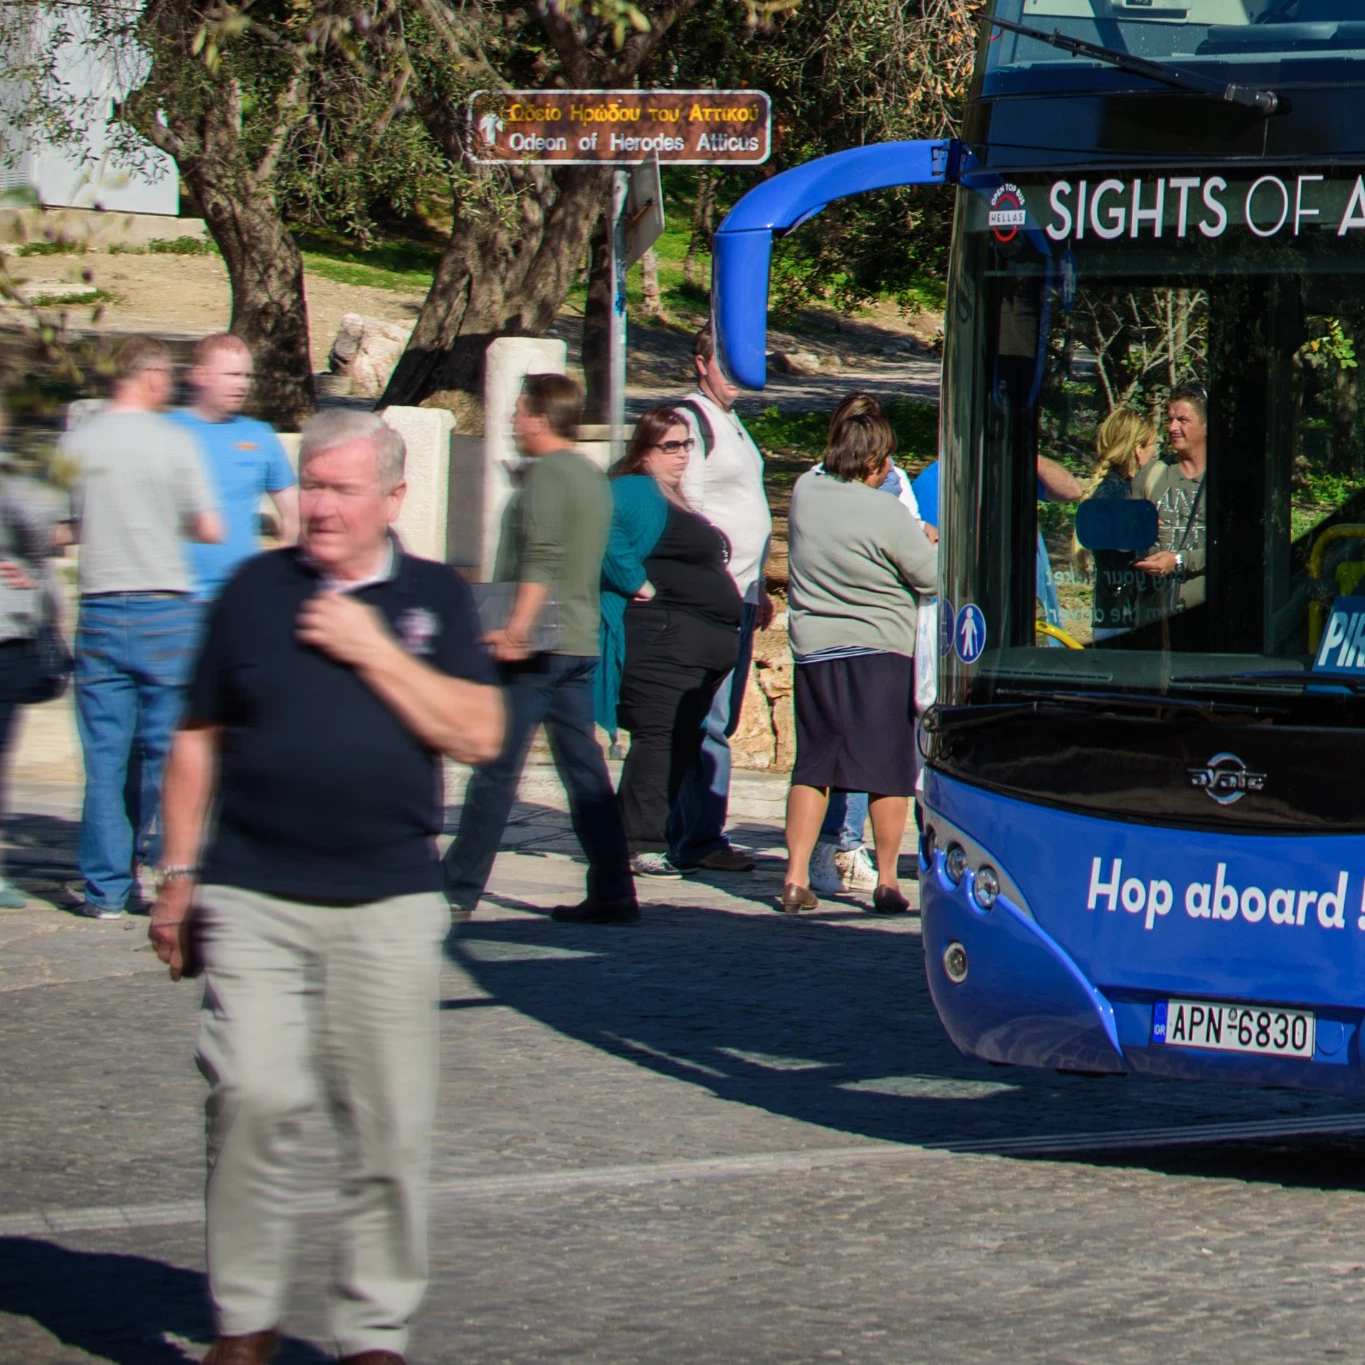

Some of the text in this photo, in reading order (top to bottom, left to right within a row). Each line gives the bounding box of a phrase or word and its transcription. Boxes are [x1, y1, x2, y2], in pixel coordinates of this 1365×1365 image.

[509, 102, 759, 126] Ωδείο Ηρώδου του Αττικού
[510, 133, 759, 152] Odeon of Herodes Atticus
[990, 212, 1024, 223] HELLAS
[1046, 176, 1228, 240] SIGHTS
[1245, 175, 1324, 237] OF
[1087, 856, 1174, 930] Hop
[1185, 862, 1349, 929] aboard
[1154, 1024, 1166, 1035] GR
